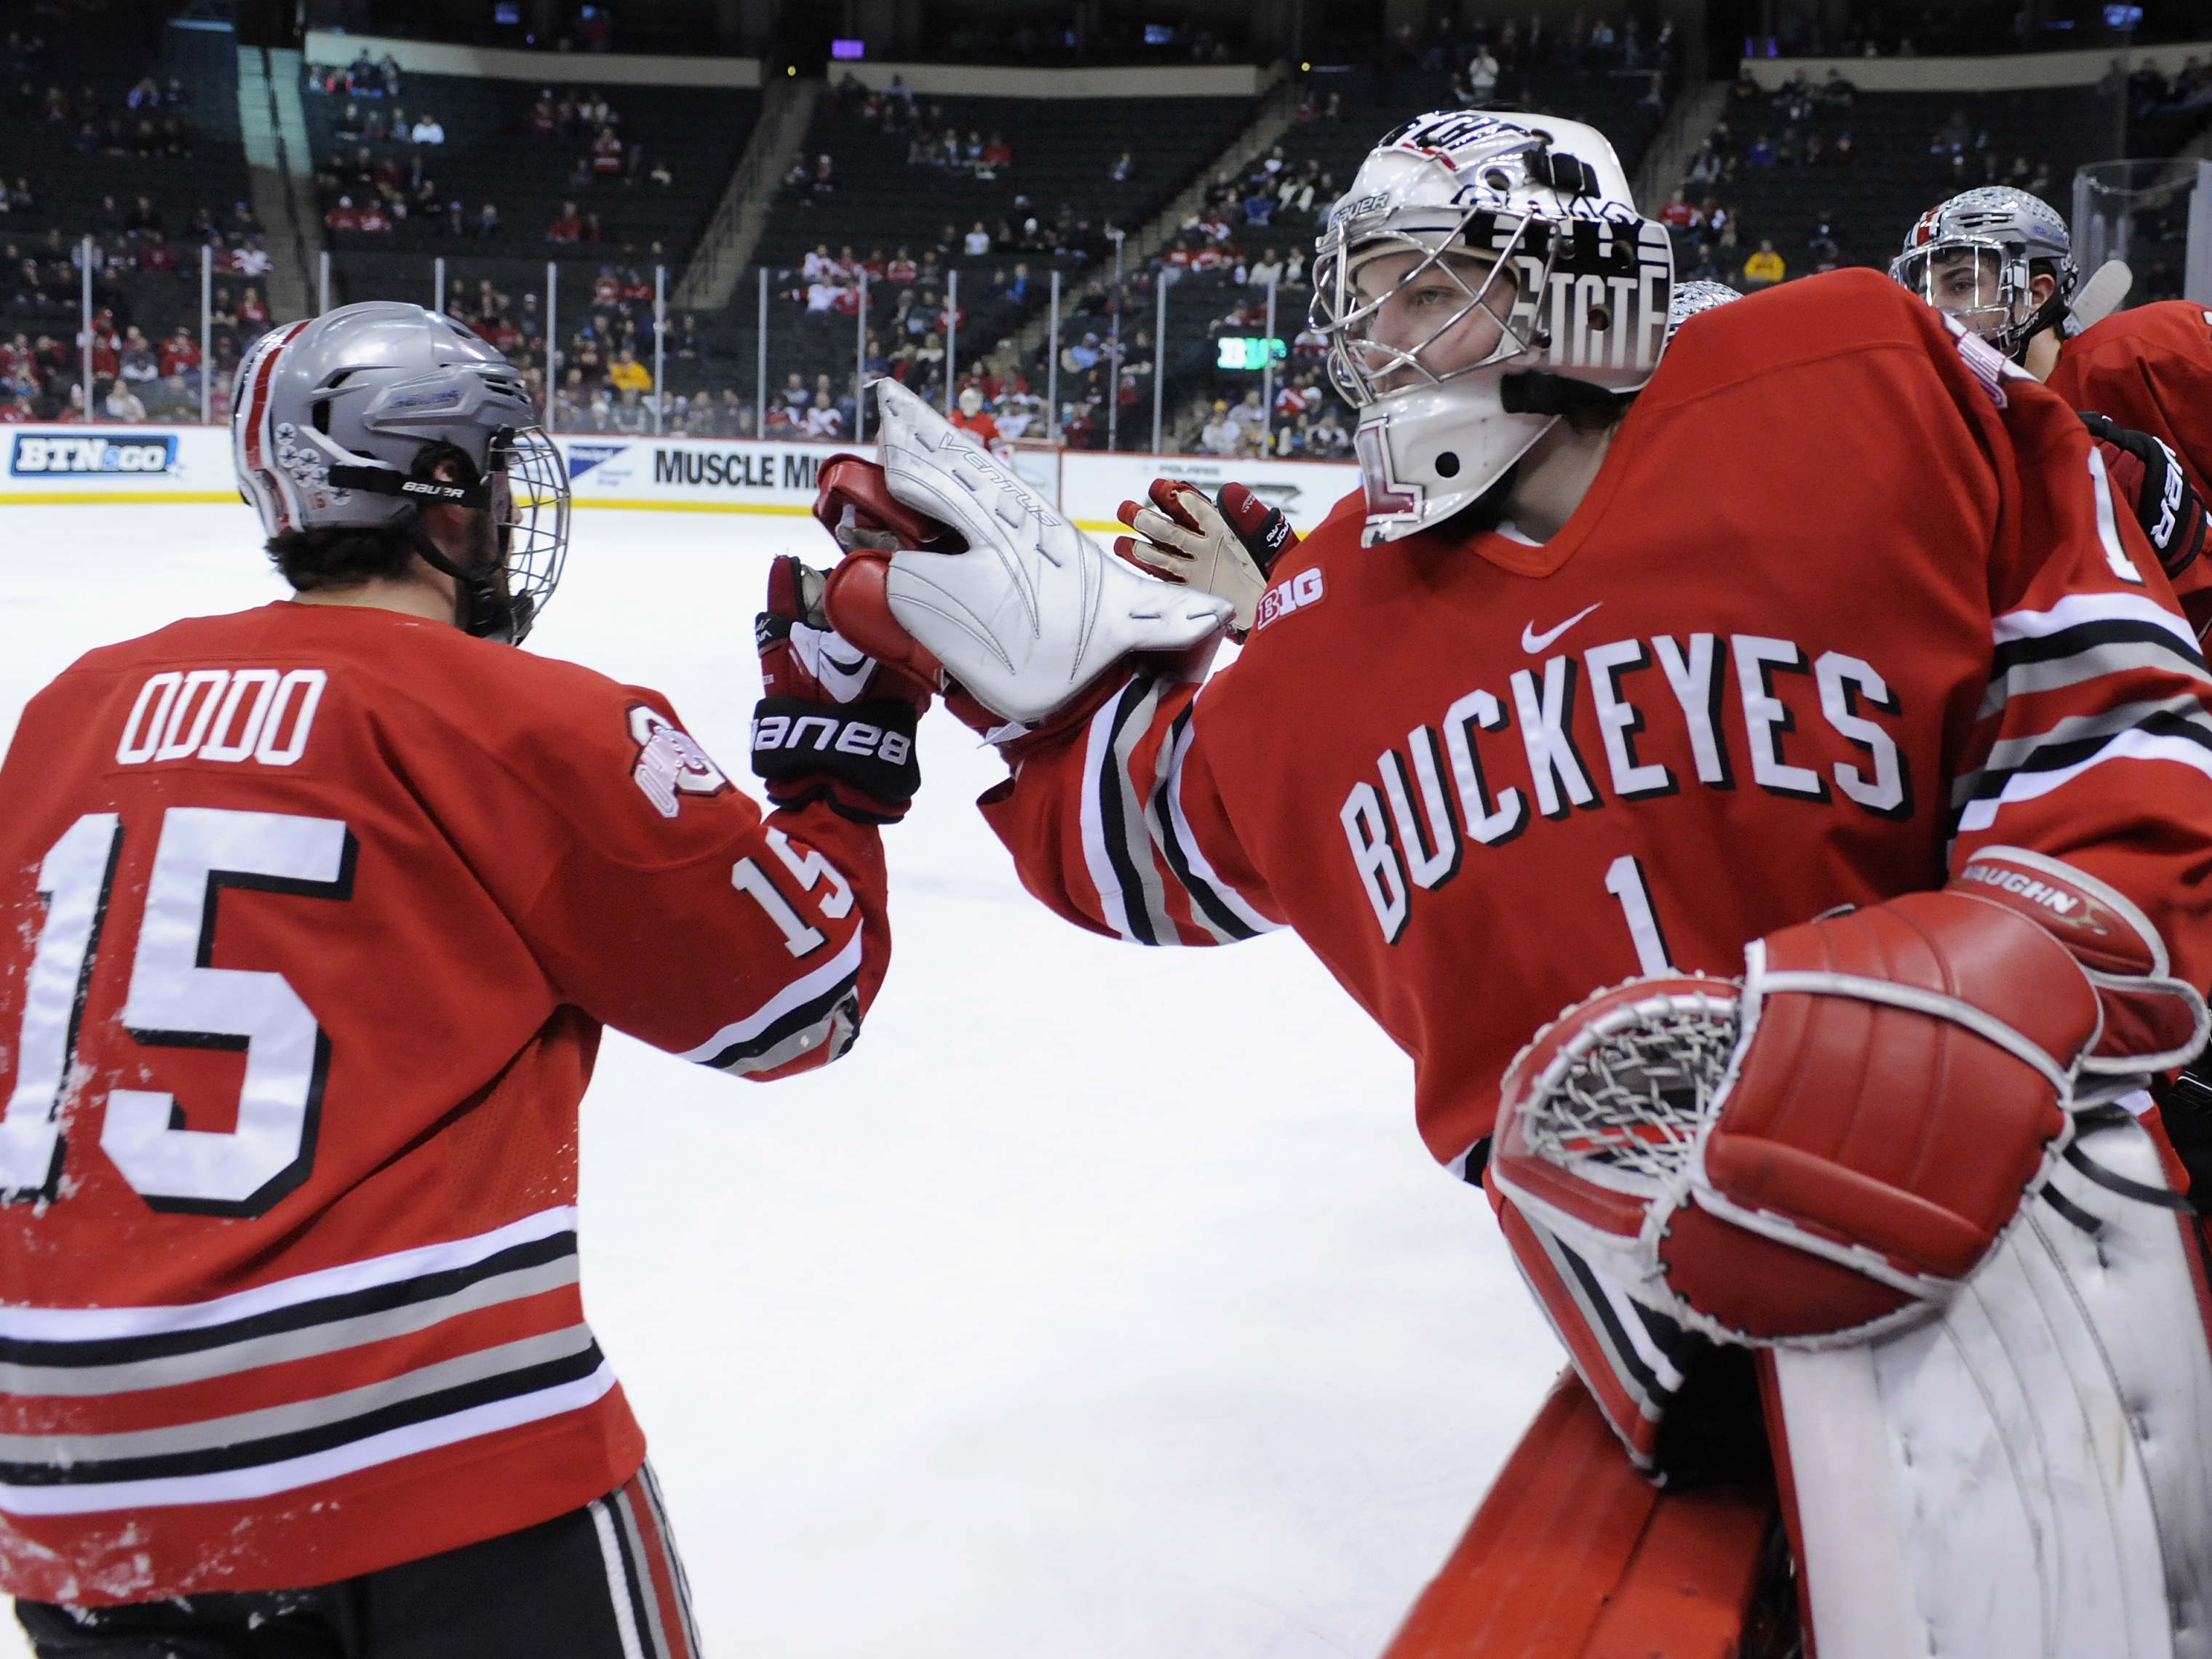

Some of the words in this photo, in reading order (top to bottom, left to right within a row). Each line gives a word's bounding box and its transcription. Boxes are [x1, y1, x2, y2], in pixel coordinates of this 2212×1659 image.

[655, 450, 775, 488] MUSCLE
[785, 455, 820, 489] MI
[116, 669, 327, 766] ODDO
[1340, 632, 1914, 945] BUCKEYES
[731, 825, 854, 958] 15
[1604, 854, 1674, 978] 1
[0, 807, 359, 1218] 15
